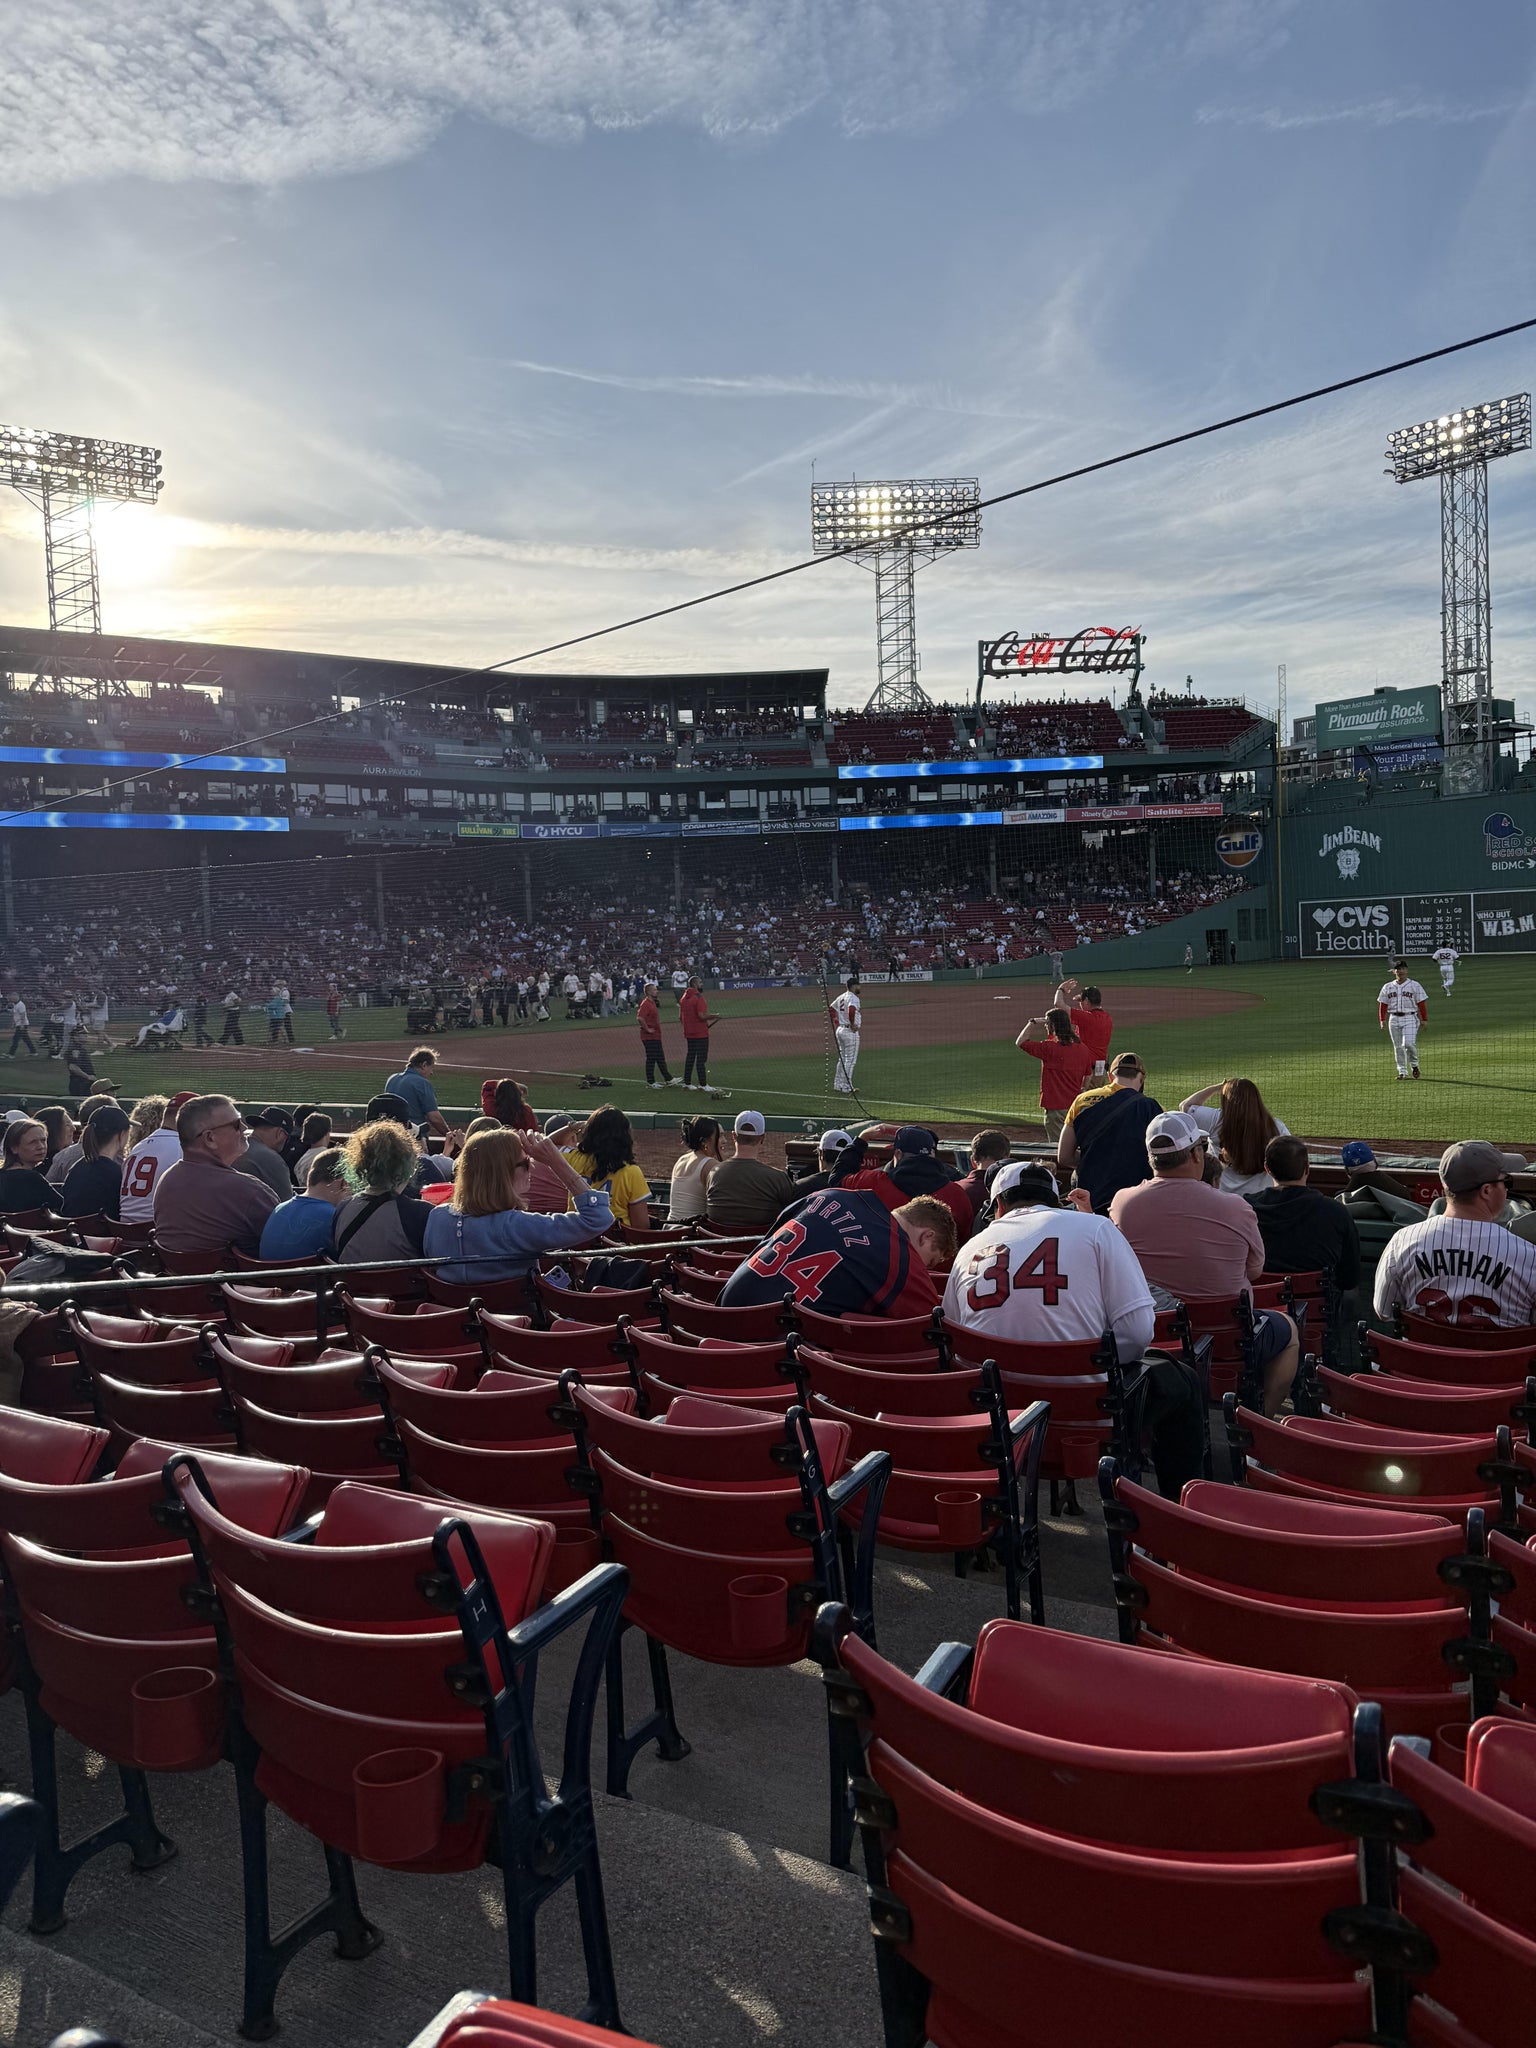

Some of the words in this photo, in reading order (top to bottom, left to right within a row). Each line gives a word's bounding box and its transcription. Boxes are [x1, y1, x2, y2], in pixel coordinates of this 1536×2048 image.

[1328, 707, 1387, 729] Plymouth
[1390, 701, 1425, 719] Rock
[1374, 756, 1394, 764] Your
[1147, 808, 1184, 816] Safelite
[460, 826, 493, 835] SULLIVAN
[550, 827, 582, 836] HYCU
[1217, 834, 1259, 852] Gulf
[1319, 833, 1344, 857] JIM
[1343, 825, 1382, 853] BEAM
[1491, 837, 1521, 849] RED
[1491, 860, 1525, 871] BIDMC
[1337, 905, 1390, 928] CVS
[1476, 911, 1495, 919] WHO
[1495, 910, 1511, 919] BUT
[1285, 935, 1298, 944] 310
[1316, 929, 1390, 951] Health
[121, 1155, 159, 1198] 19
[806, 1195, 871, 1248] ORTIZ
[746, 1218, 844, 1304] 34
[1414, 1248, 1512, 1291] NATHAN
[966, 1236, 1069, 1312] 34
[808, 1464, 816, 1479] G
[472, 1597, 488, 1622] H
